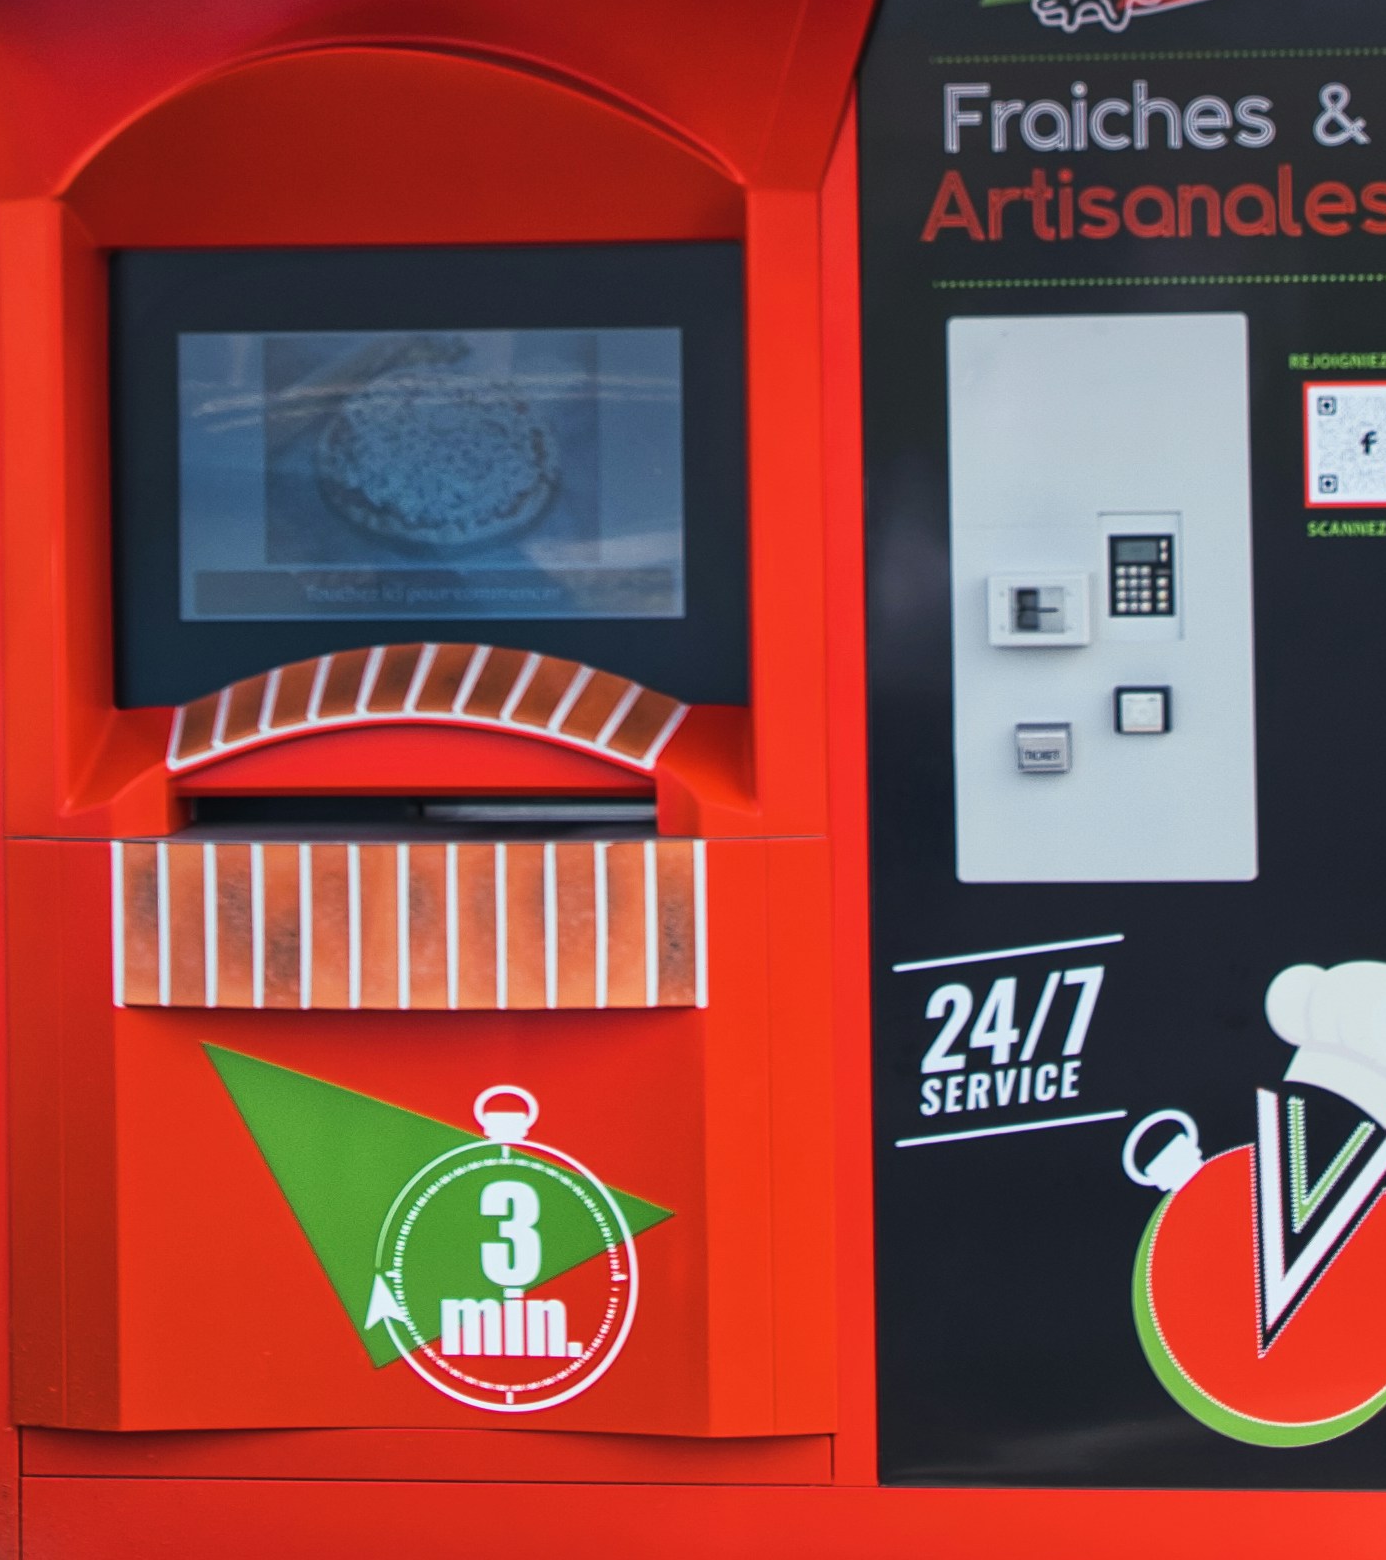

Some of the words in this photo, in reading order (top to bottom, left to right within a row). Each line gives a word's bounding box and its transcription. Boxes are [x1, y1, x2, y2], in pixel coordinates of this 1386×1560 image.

[943, 80, 1277, 154] Fraiches
[1312, 82, 1371, 147] &
[920, 965, 1106, 1076] 24/7
[918, 1061, 1082, 1118] SERVICE
[479, 1179, 542, 1288] 3
[440, 1287, 585, 1359] min.
